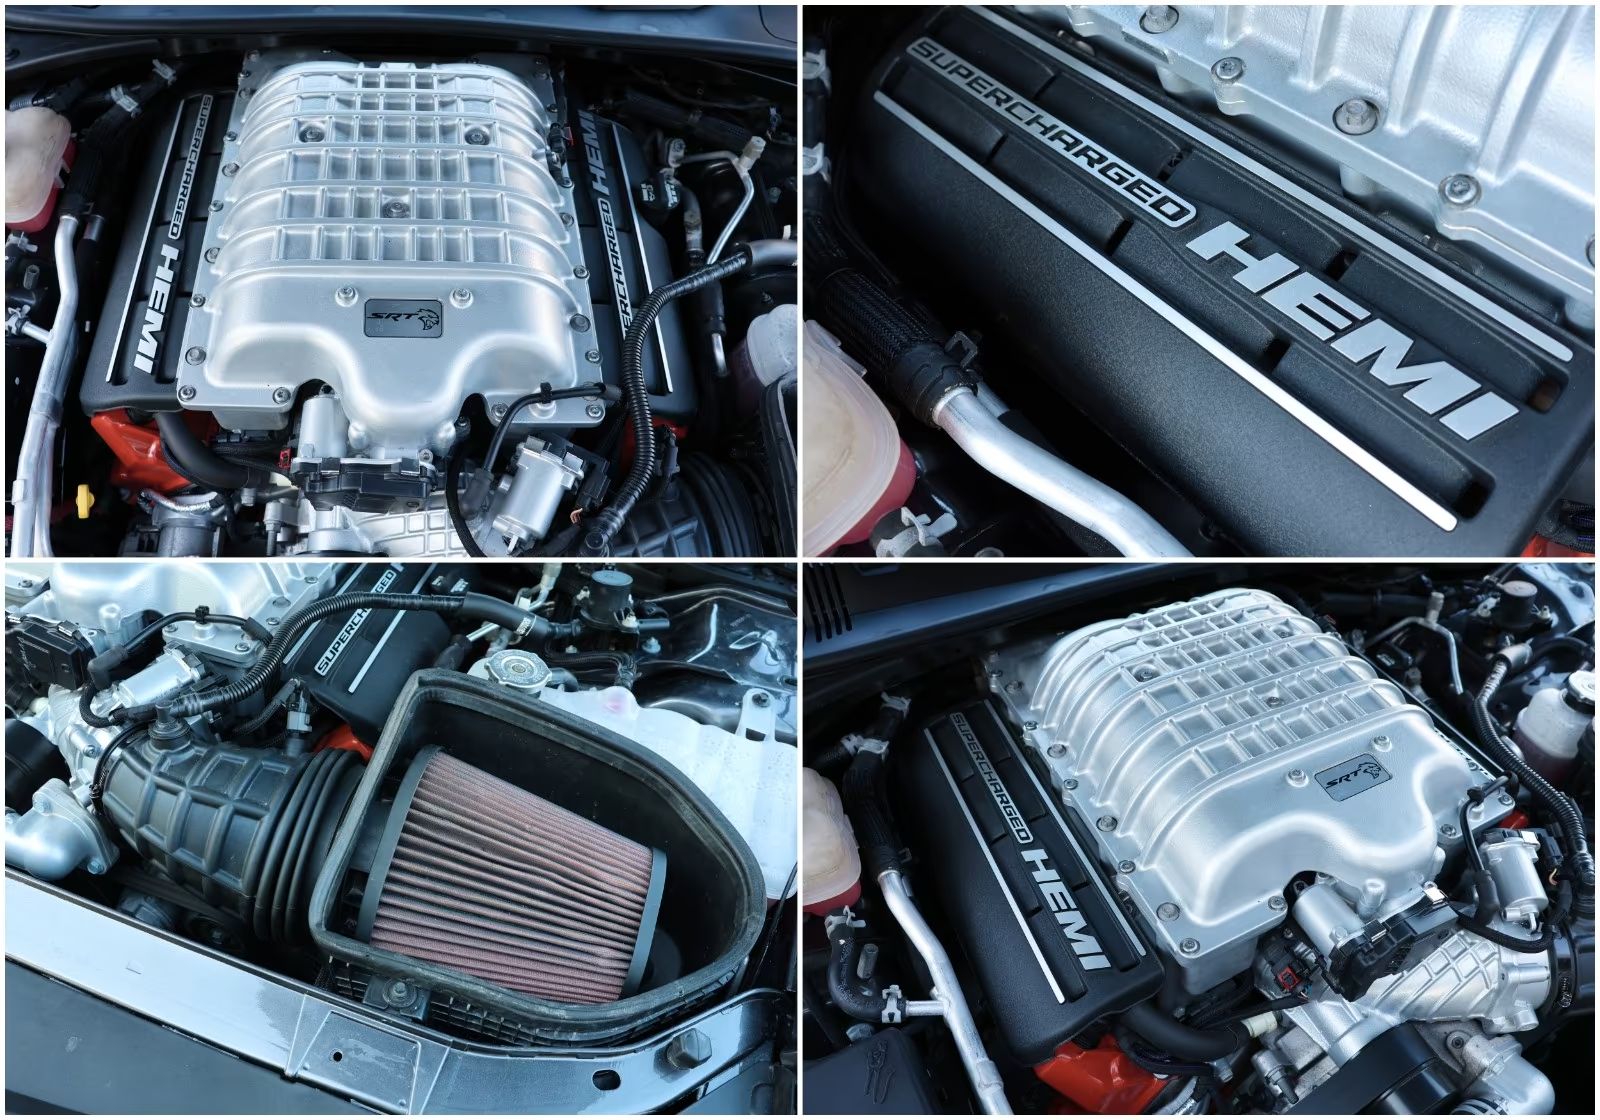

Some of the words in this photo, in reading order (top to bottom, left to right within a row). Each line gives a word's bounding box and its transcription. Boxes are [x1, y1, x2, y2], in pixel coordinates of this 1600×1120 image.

[169, 97, 212, 239] SUPERCHARGED
[577, 109, 610, 196] HEMI
[601, 200, 632, 333] ERCHARGED
[911, 40, 1193, 223] SUPERCHARGED
[1185, 221, 1520, 441] HEMI
[133, 244, 180, 375] HEMI
[366, 312, 419, 322] SRT
[317, 570, 395, 672] SUPERCHGED
[952, 714, 1031, 842] SUPERCHARGED
[1021, 849, 1112, 971] HEMI
[1325, 768, 1361, 789] SRT
